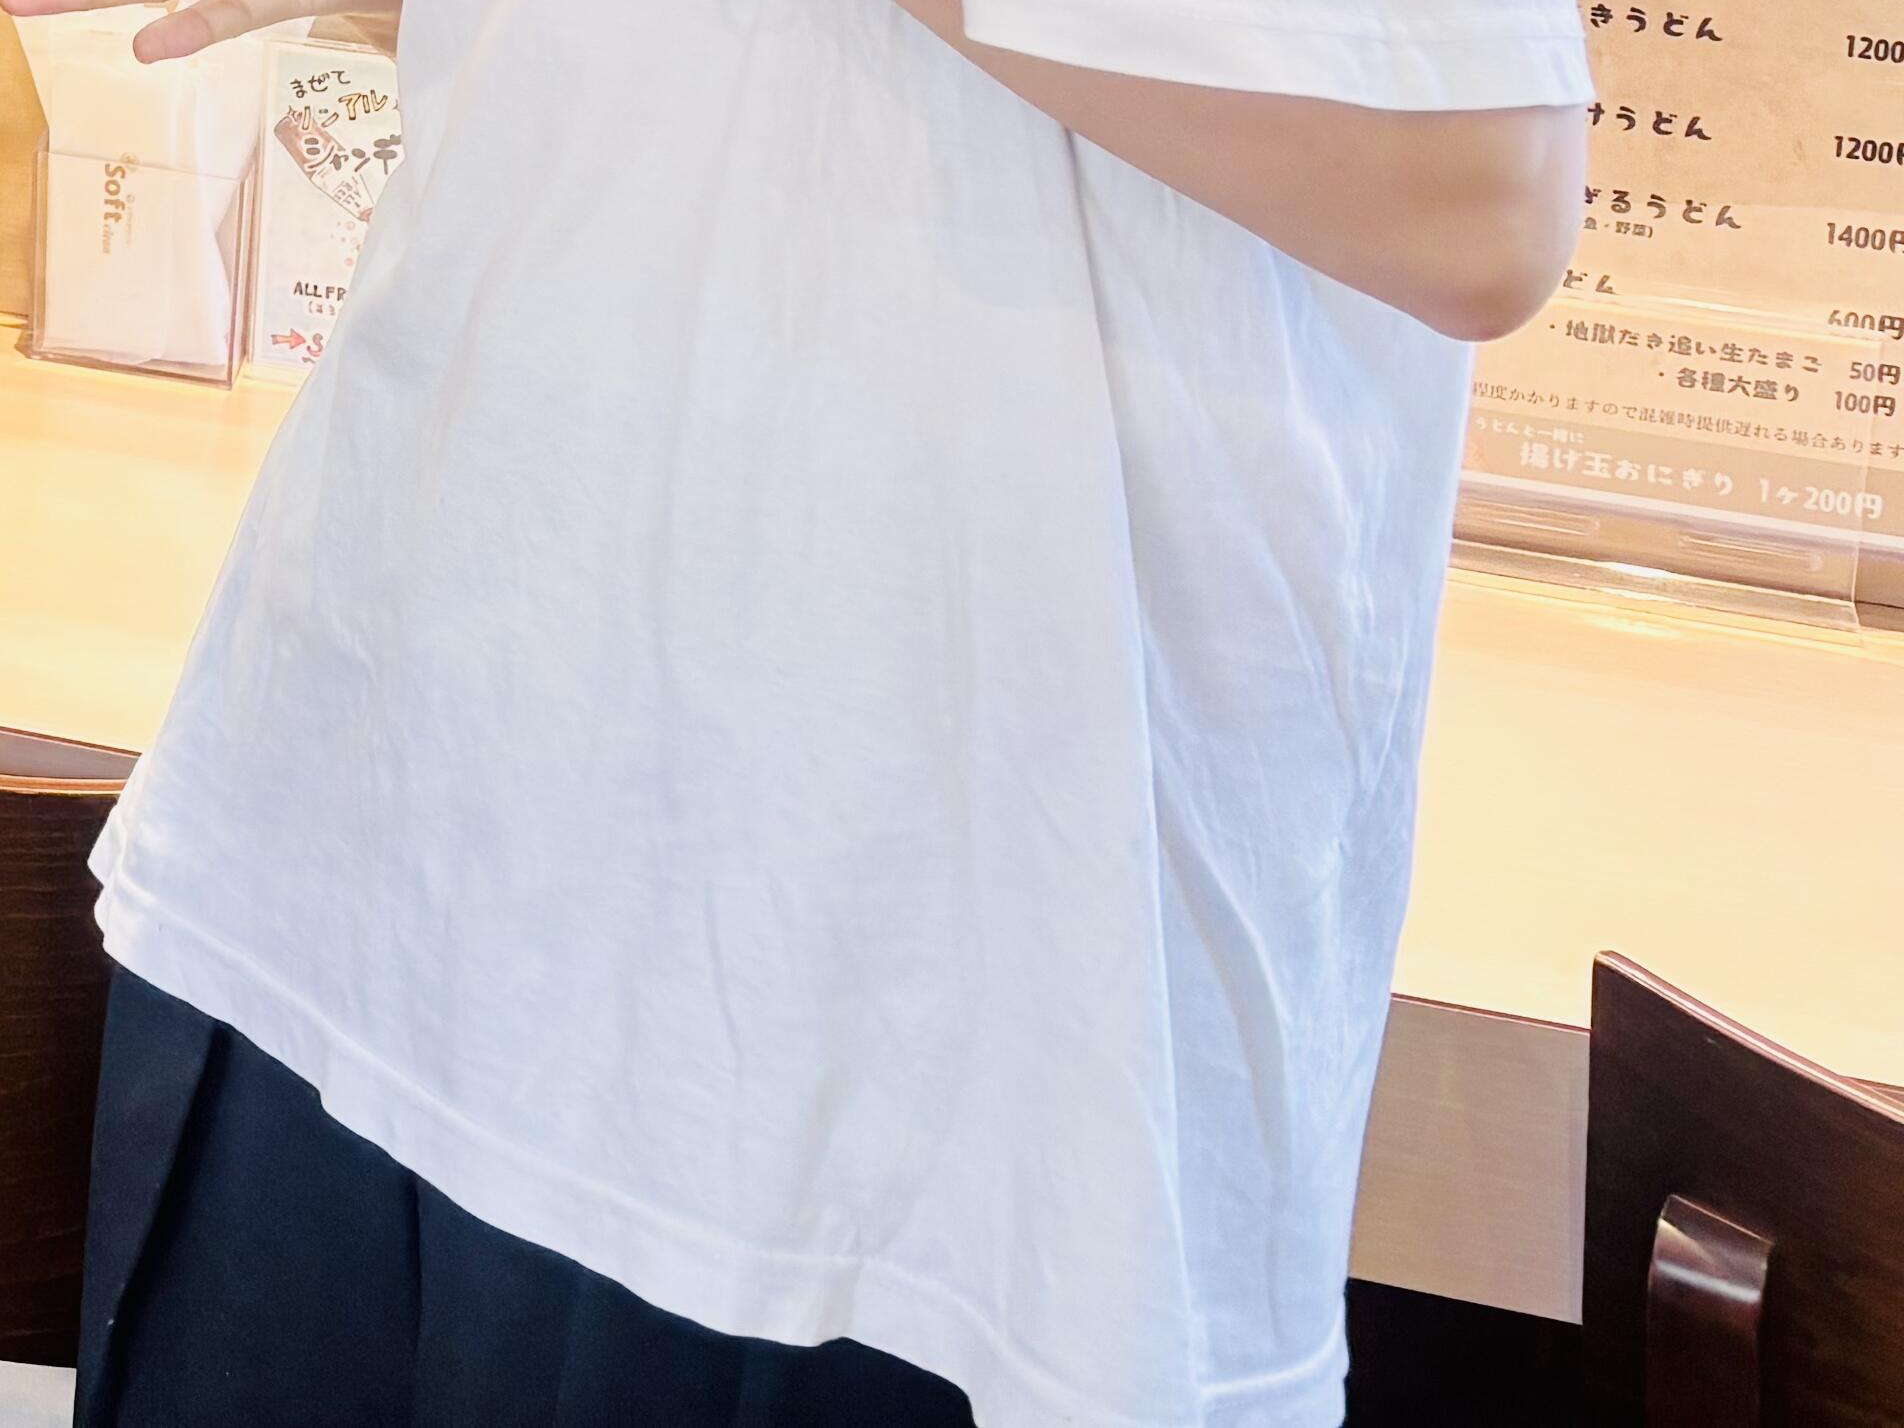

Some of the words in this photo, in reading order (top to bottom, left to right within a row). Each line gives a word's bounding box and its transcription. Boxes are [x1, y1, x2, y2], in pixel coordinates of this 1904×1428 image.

[290, 70, 351, 99] まぜて
[104, 162, 126, 224] Soft
[294, 281, 323, 298] ALL
[1849, 362, 1901, 385] 50円
[1834, 390, 1895, 416] 100円
[1519, 442, 1734, 496] 揚げ玉おにぎり
